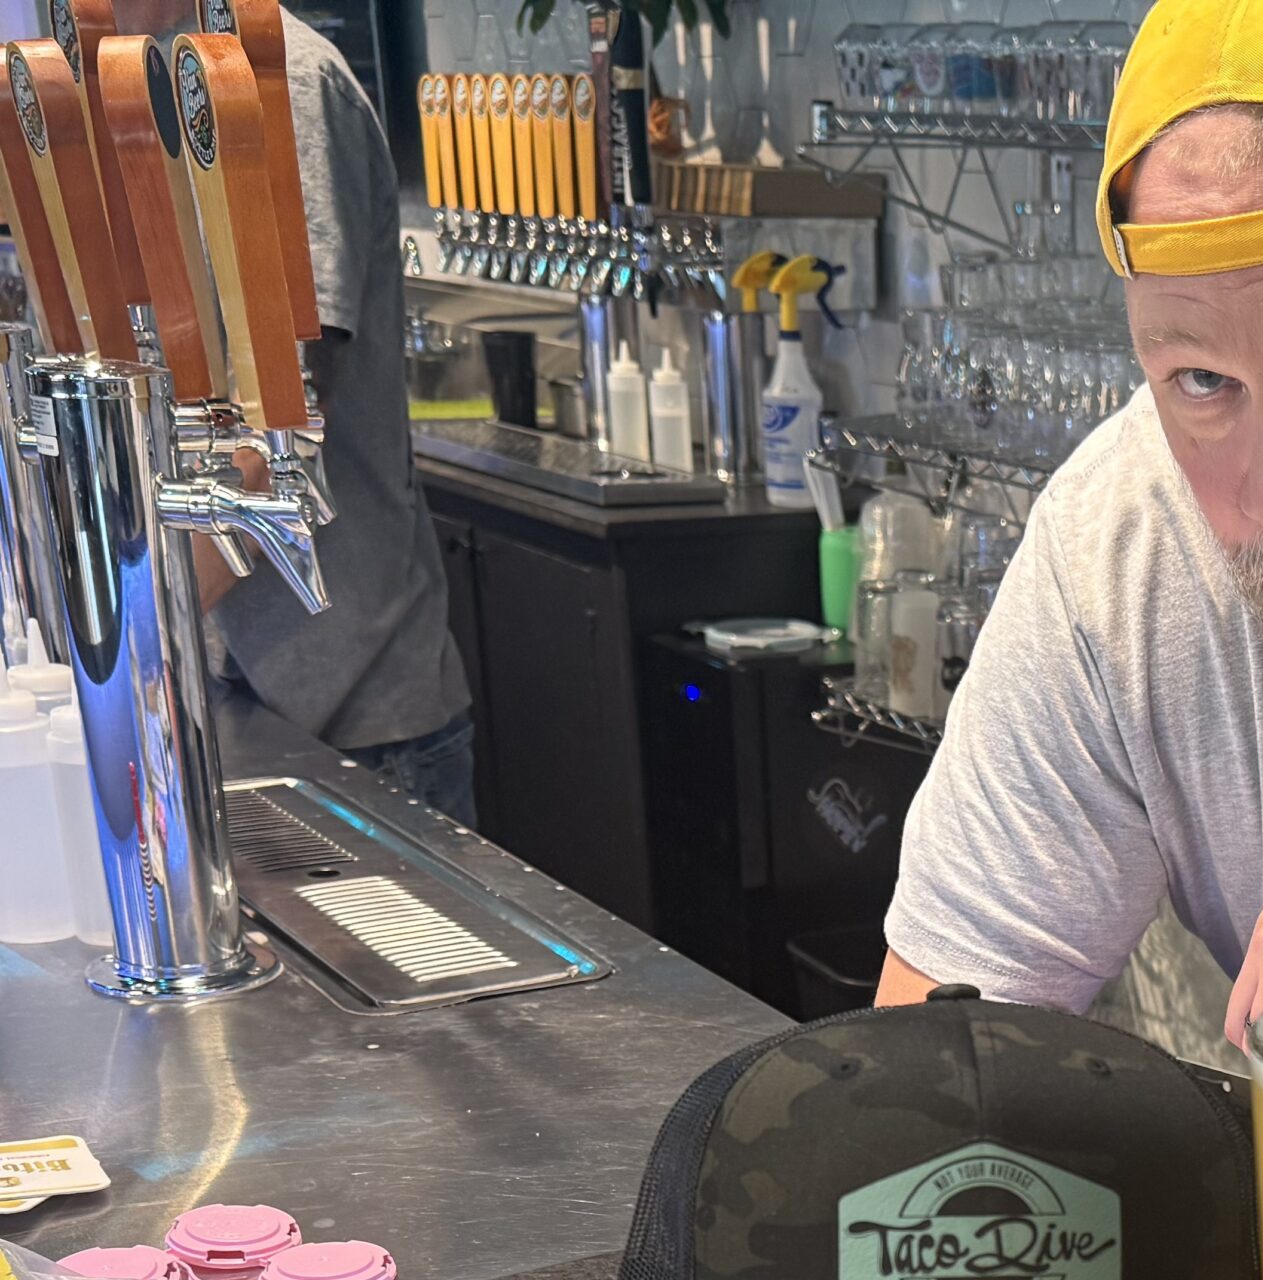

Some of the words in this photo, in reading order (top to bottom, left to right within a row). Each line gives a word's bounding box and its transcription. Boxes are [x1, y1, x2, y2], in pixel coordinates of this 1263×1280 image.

[933, 1171, 955, 1191] NOT
[957, 1162, 986, 1180] YOUR
[990, 1162, 1035, 1190] AVERAGE
[849, 1219, 969, 1277] Taco
[965, 1217, 1116, 1274] Dive
